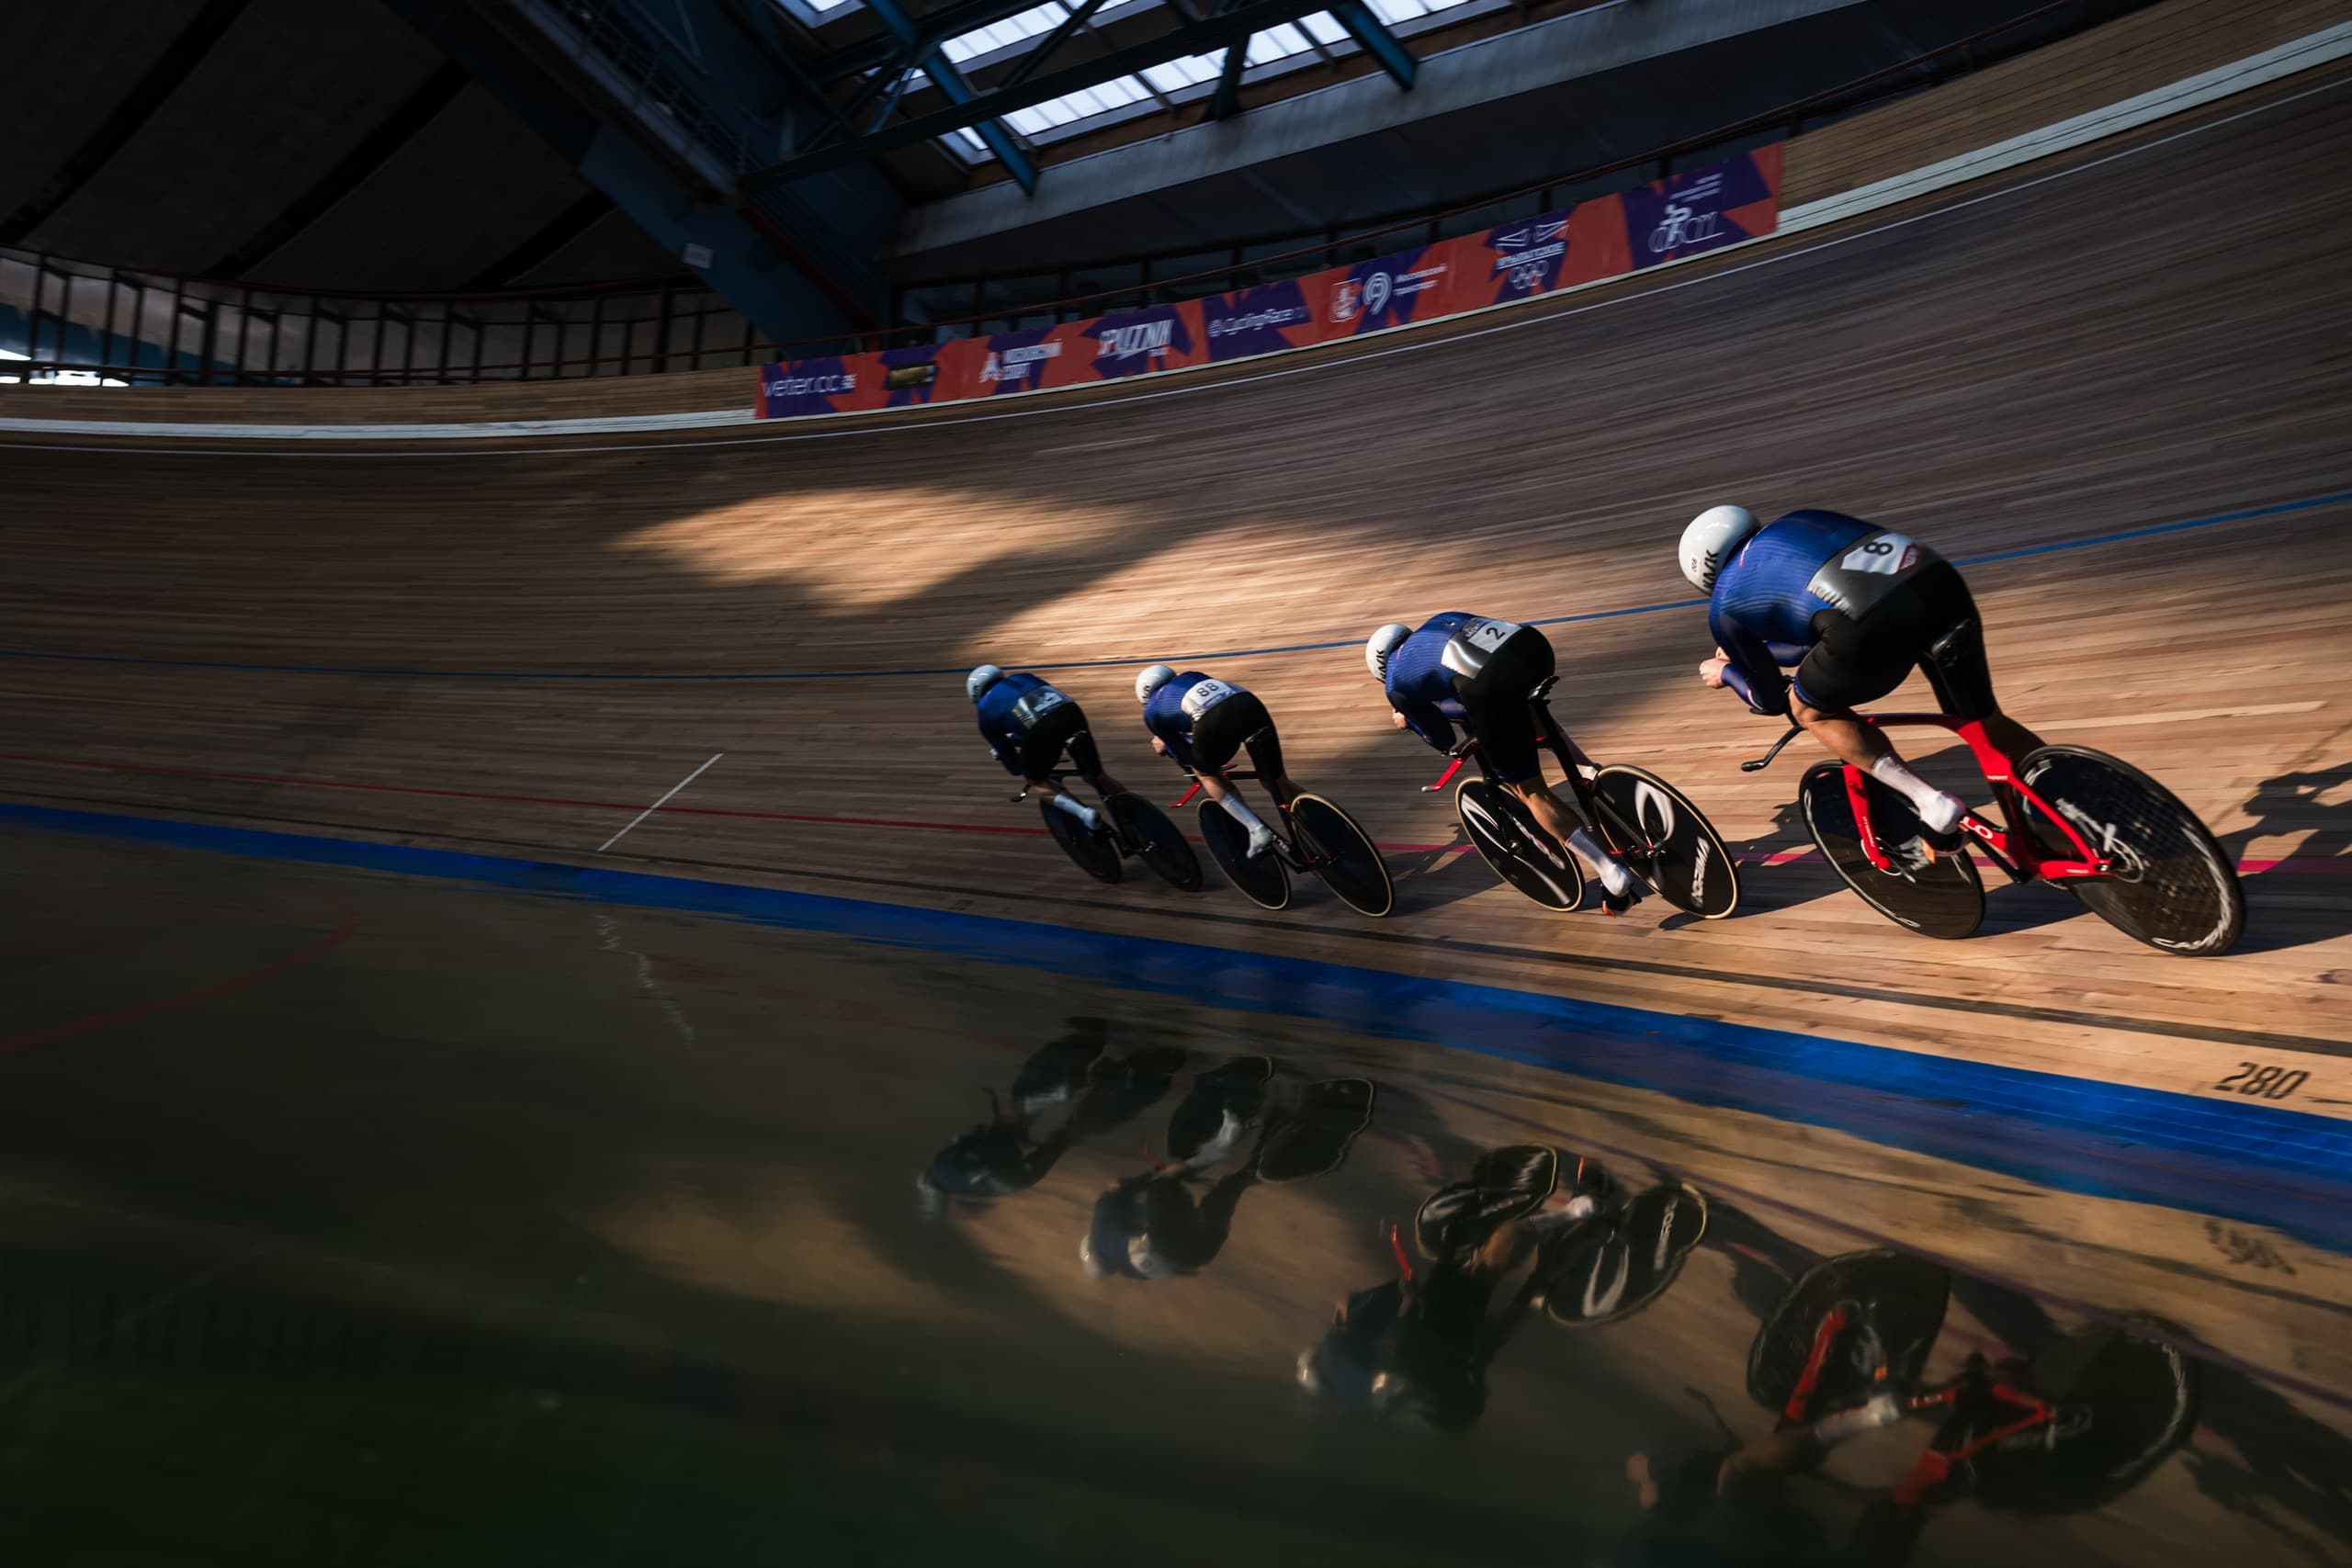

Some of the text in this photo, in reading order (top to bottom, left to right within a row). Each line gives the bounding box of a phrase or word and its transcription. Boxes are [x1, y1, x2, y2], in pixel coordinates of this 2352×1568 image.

[1864, 540, 1894, 558] 8
[1486, 626, 1506, 640] 2
[1197, 682, 1219, 697] 88
[2212, 1061, 2311, 1100] 280
